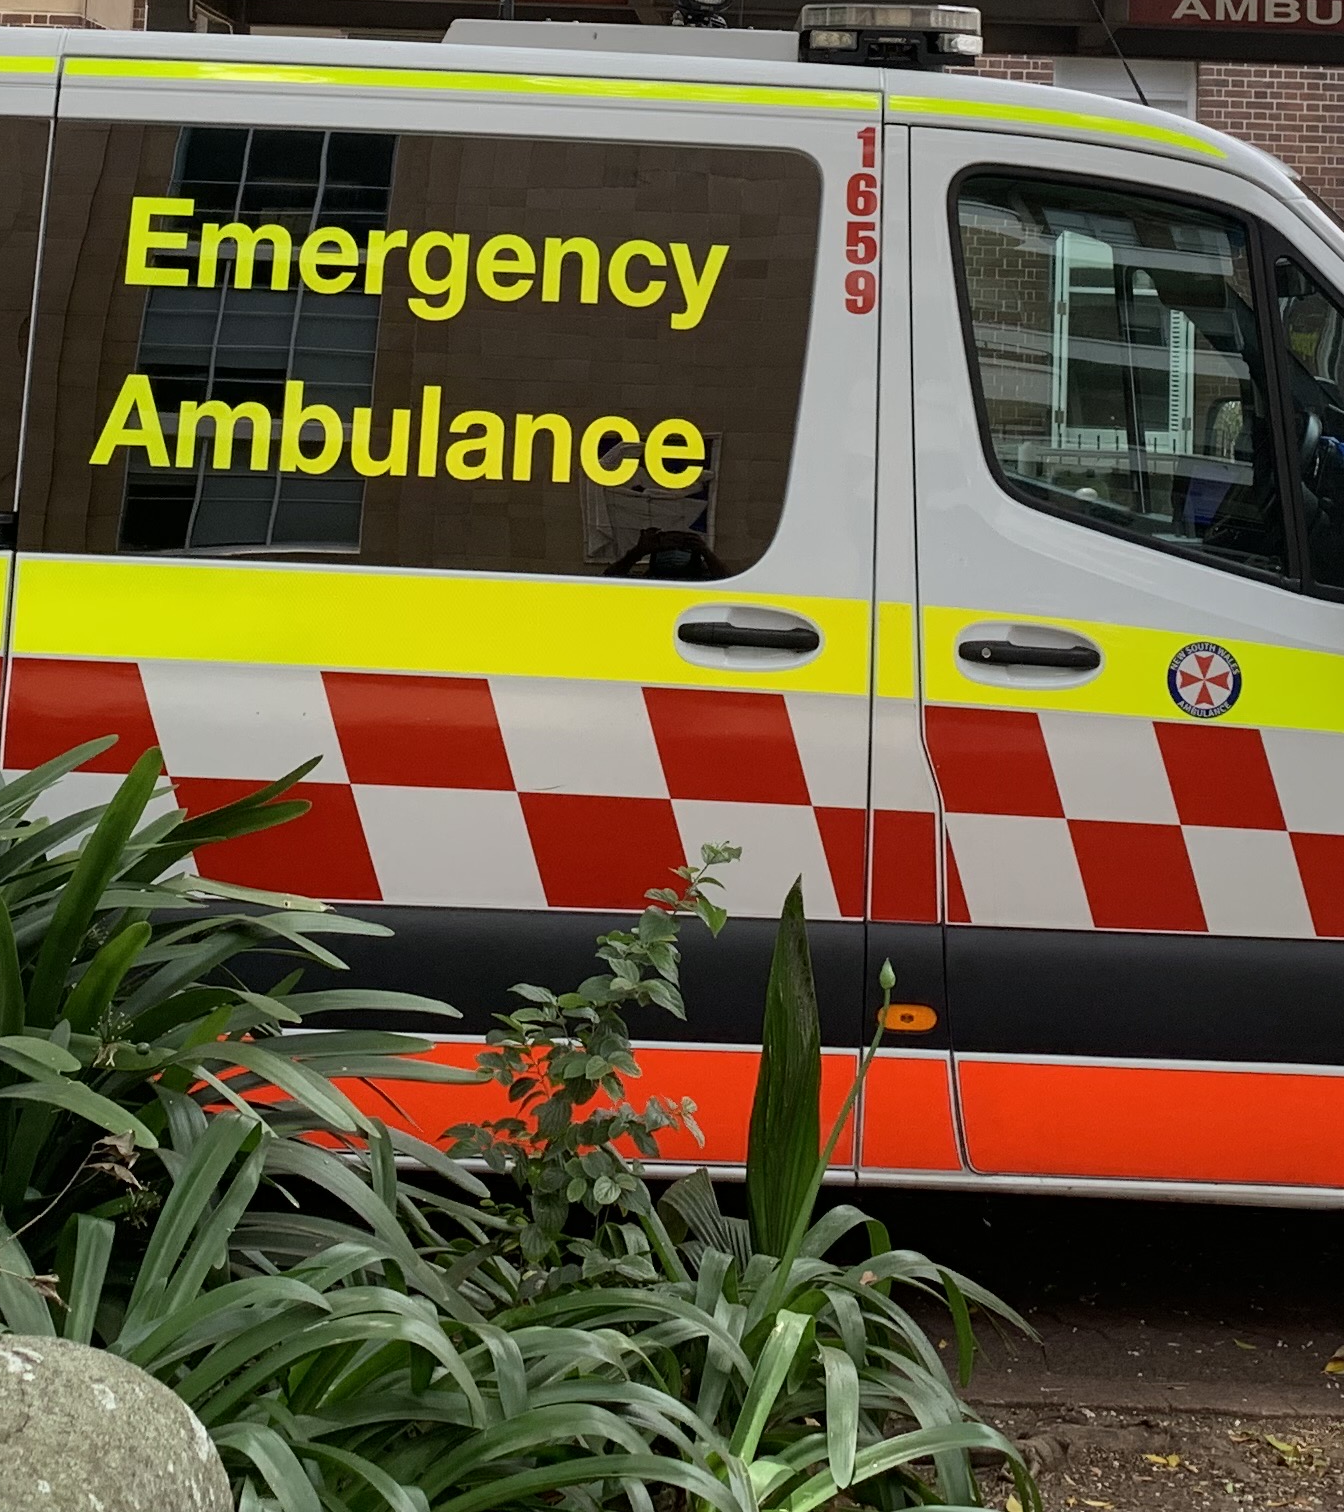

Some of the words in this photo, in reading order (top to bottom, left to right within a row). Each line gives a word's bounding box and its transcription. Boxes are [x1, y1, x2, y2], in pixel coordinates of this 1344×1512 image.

[123, 196, 730, 331] Emergency
[844, 126, 878, 315] 1659
[88, 373, 706, 490] Ambulance
[1170, 651, 1187, 671] NEW
[1186, 642, 1216, 655] SOUTH
[1217, 647, 1241, 675] WALES
[1177, 700, 1232, 718] AMBULANCE
